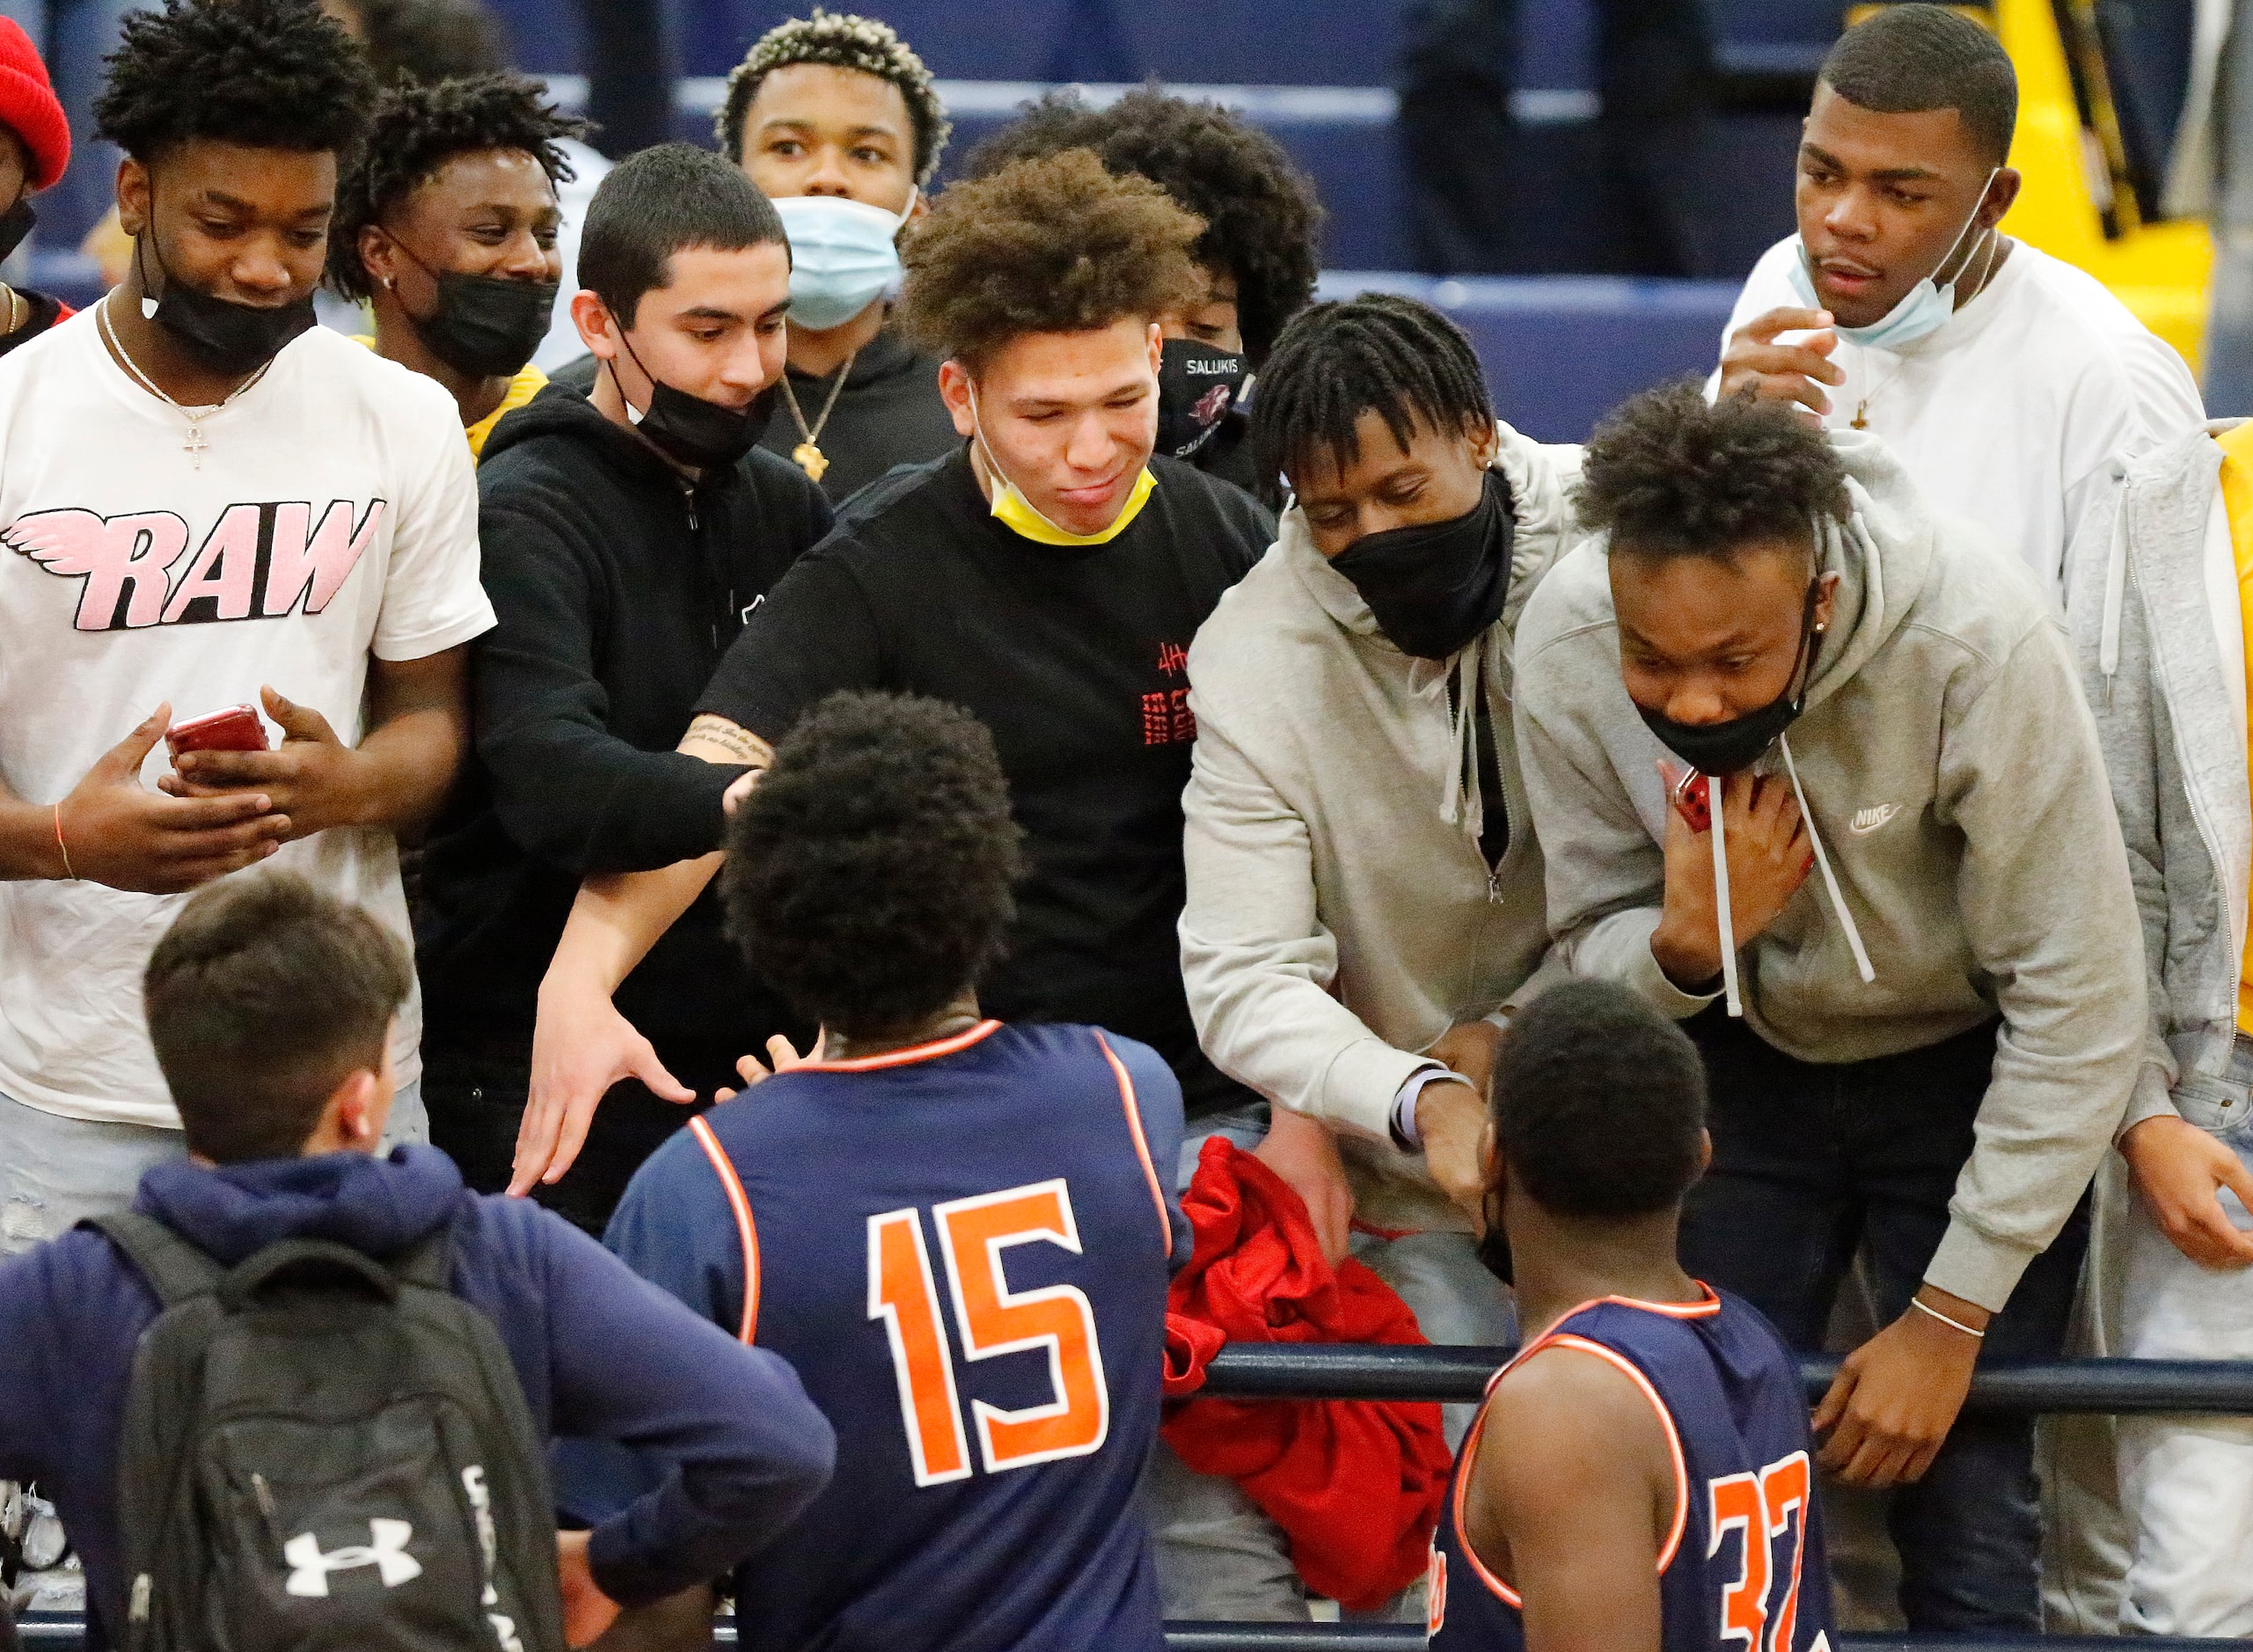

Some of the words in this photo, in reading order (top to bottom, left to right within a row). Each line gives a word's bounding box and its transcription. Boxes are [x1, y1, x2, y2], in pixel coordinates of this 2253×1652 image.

[1187, 359, 1239, 375] SALUKIS
[1, 499, 388, 631] RAW
[1854, 803, 1891, 827] NIKE
[867, 1177, 1110, 1488] 15
